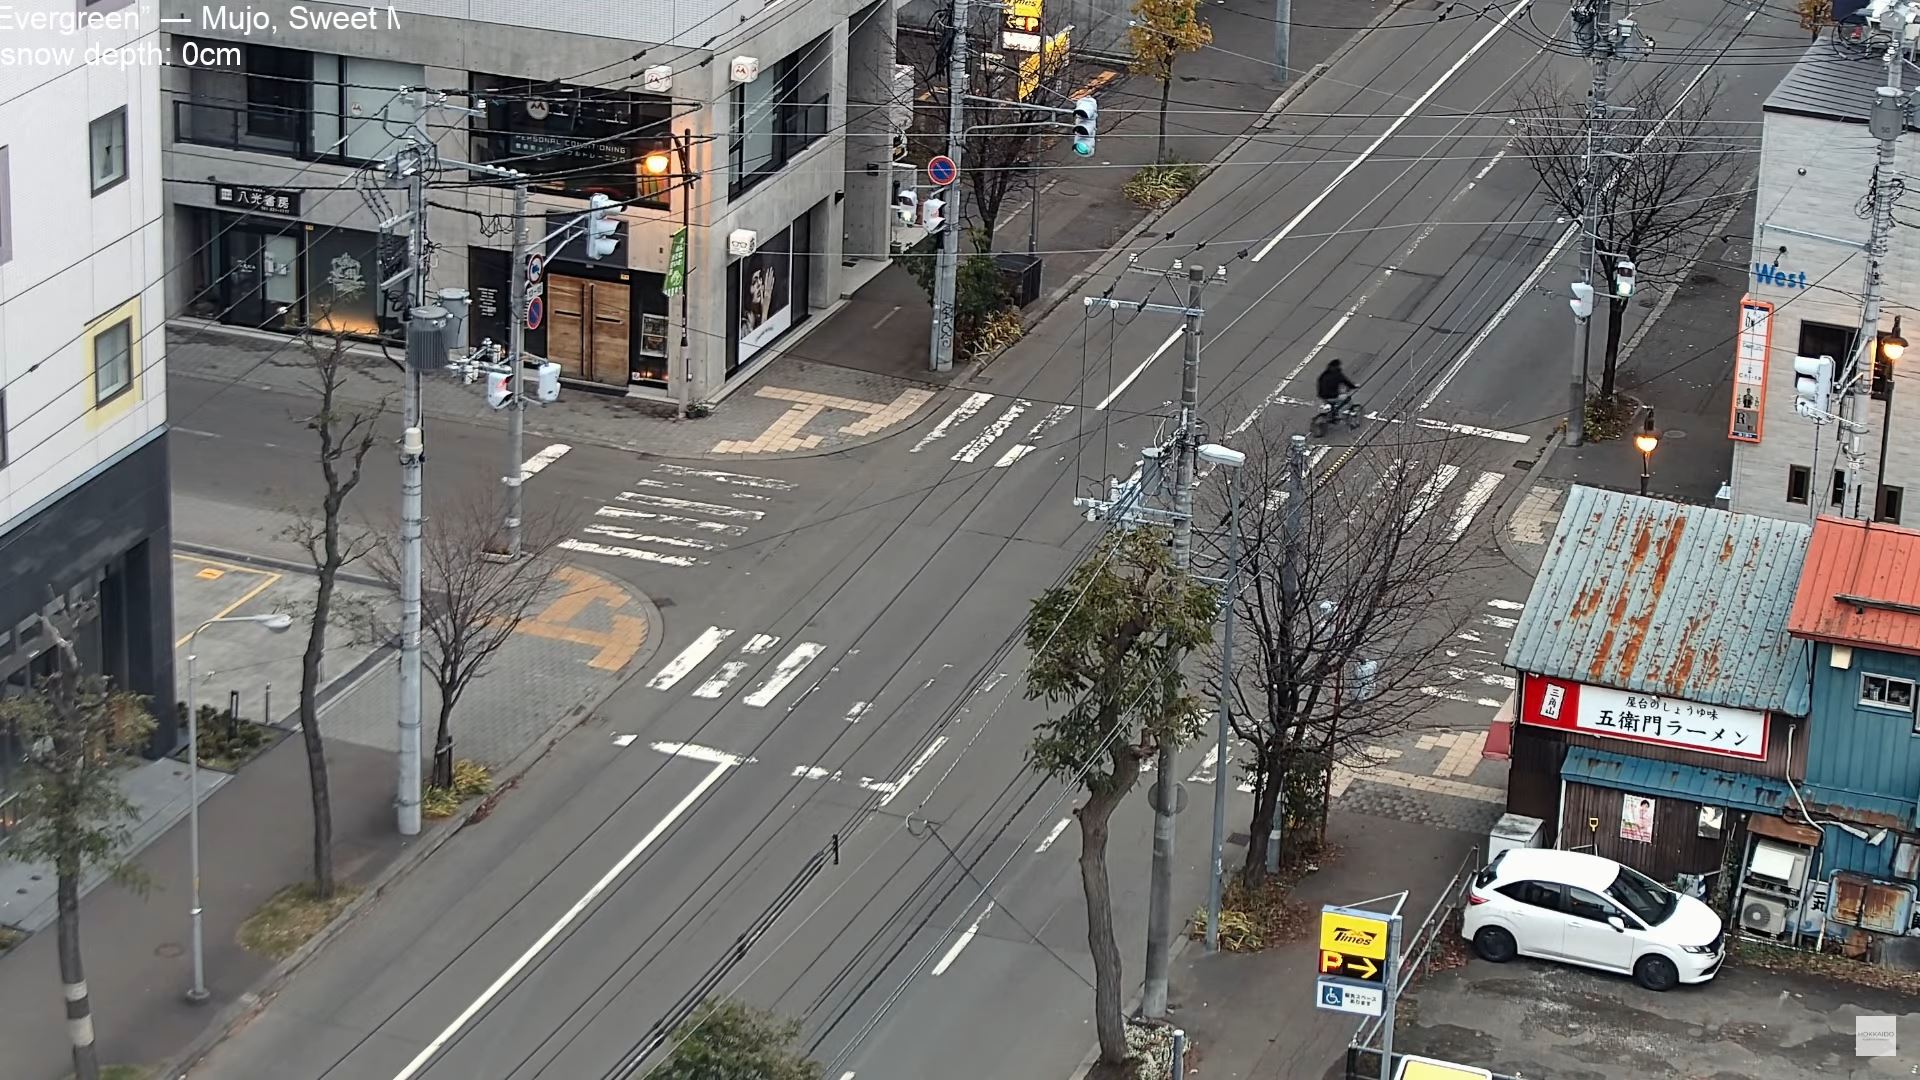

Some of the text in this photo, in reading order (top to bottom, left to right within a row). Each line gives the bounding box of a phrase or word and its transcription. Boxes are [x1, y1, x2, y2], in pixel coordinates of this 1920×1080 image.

[1755, 262, 1806, 289] West
[1545, 688, 1559, 716] 三角山
[1626, 696, 1719, 721] 屋台のしょうゆ味
[1596, 710, 1749, 746] 五衛門ラーメン
[1334, 927, 1374, 946] Times
[1322, 950, 1343, 973] P
